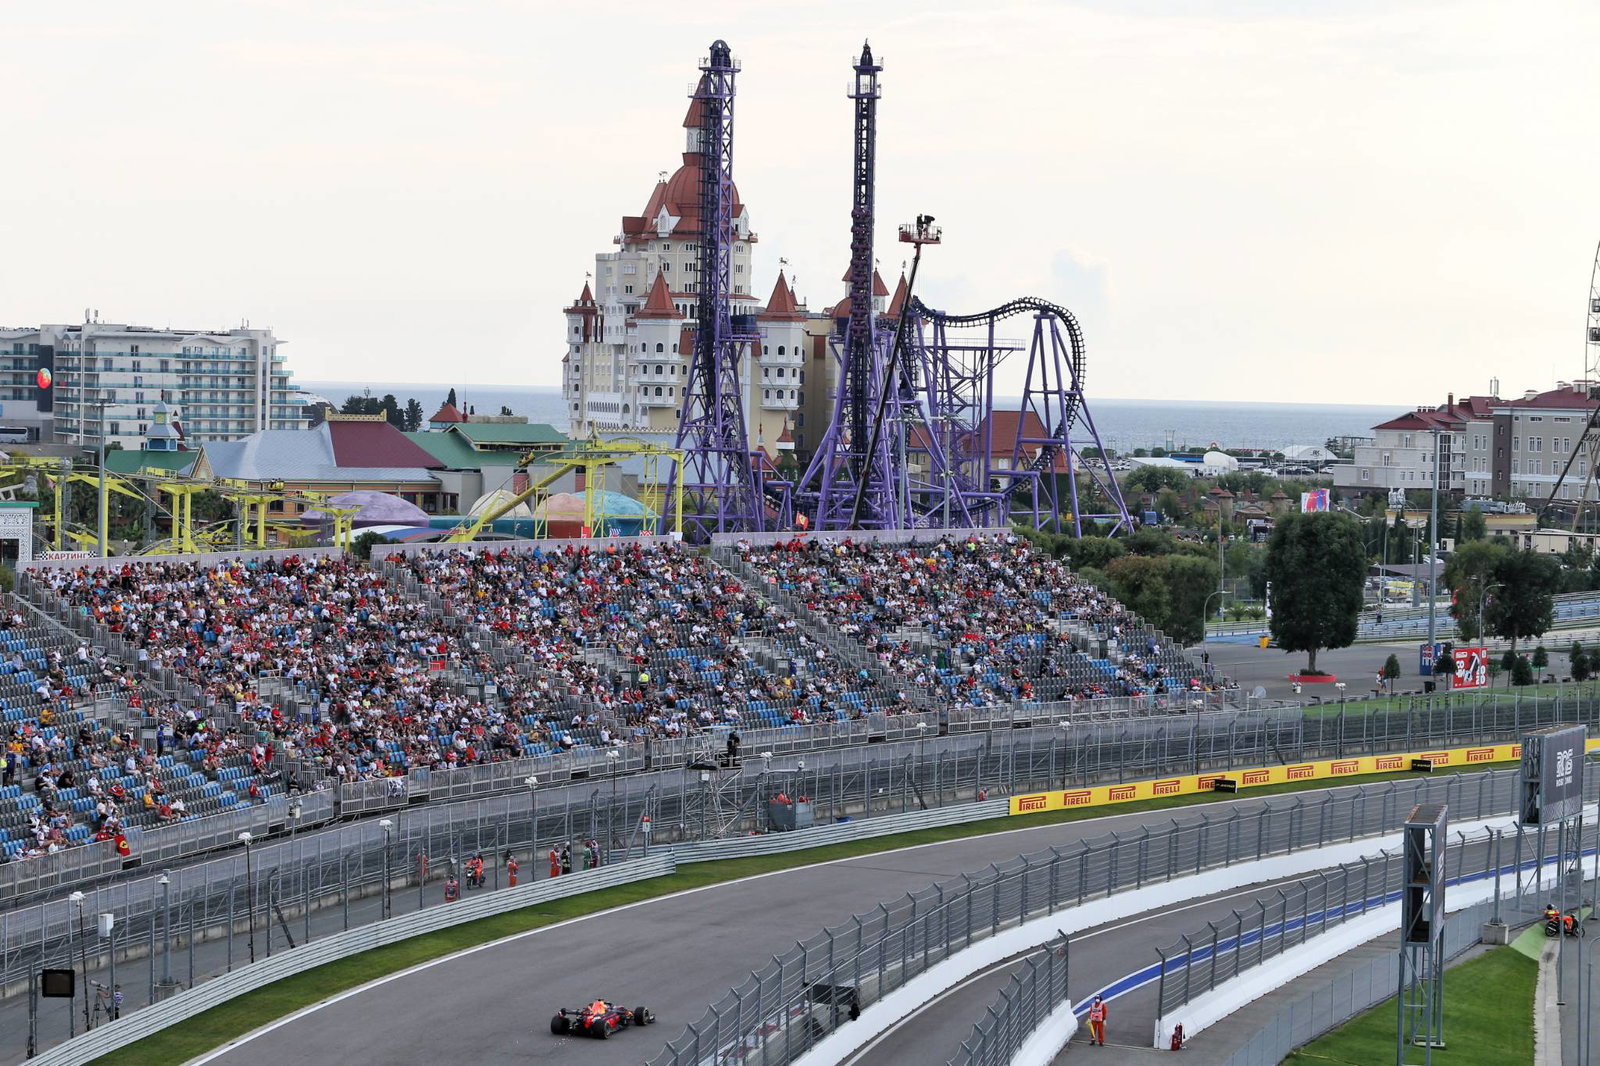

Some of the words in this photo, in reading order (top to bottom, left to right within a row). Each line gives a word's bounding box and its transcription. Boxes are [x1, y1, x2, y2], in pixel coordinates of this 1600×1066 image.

[48, 552, 86, 560] КАРТИНГ
[1421, 753, 1448, 765] PELLI
[1467, 748, 1494, 761] PIRELLI
[1331, 761, 1358, 775] PIRELLI
[1375, 757, 1402, 770] PIRELLI
[1243, 770, 1269, 784] PIRELLI
[1286, 765, 1313, 779] PIRELLI
[1153, 780, 1180, 795] PIRELLI
[1198, 775, 1225, 789] PIRE
[1064, 791, 1091, 806] PIRELLI
[1109, 785, 1136, 801] PIRELLI
[1019, 796, 1046, 812] PIRELLI
